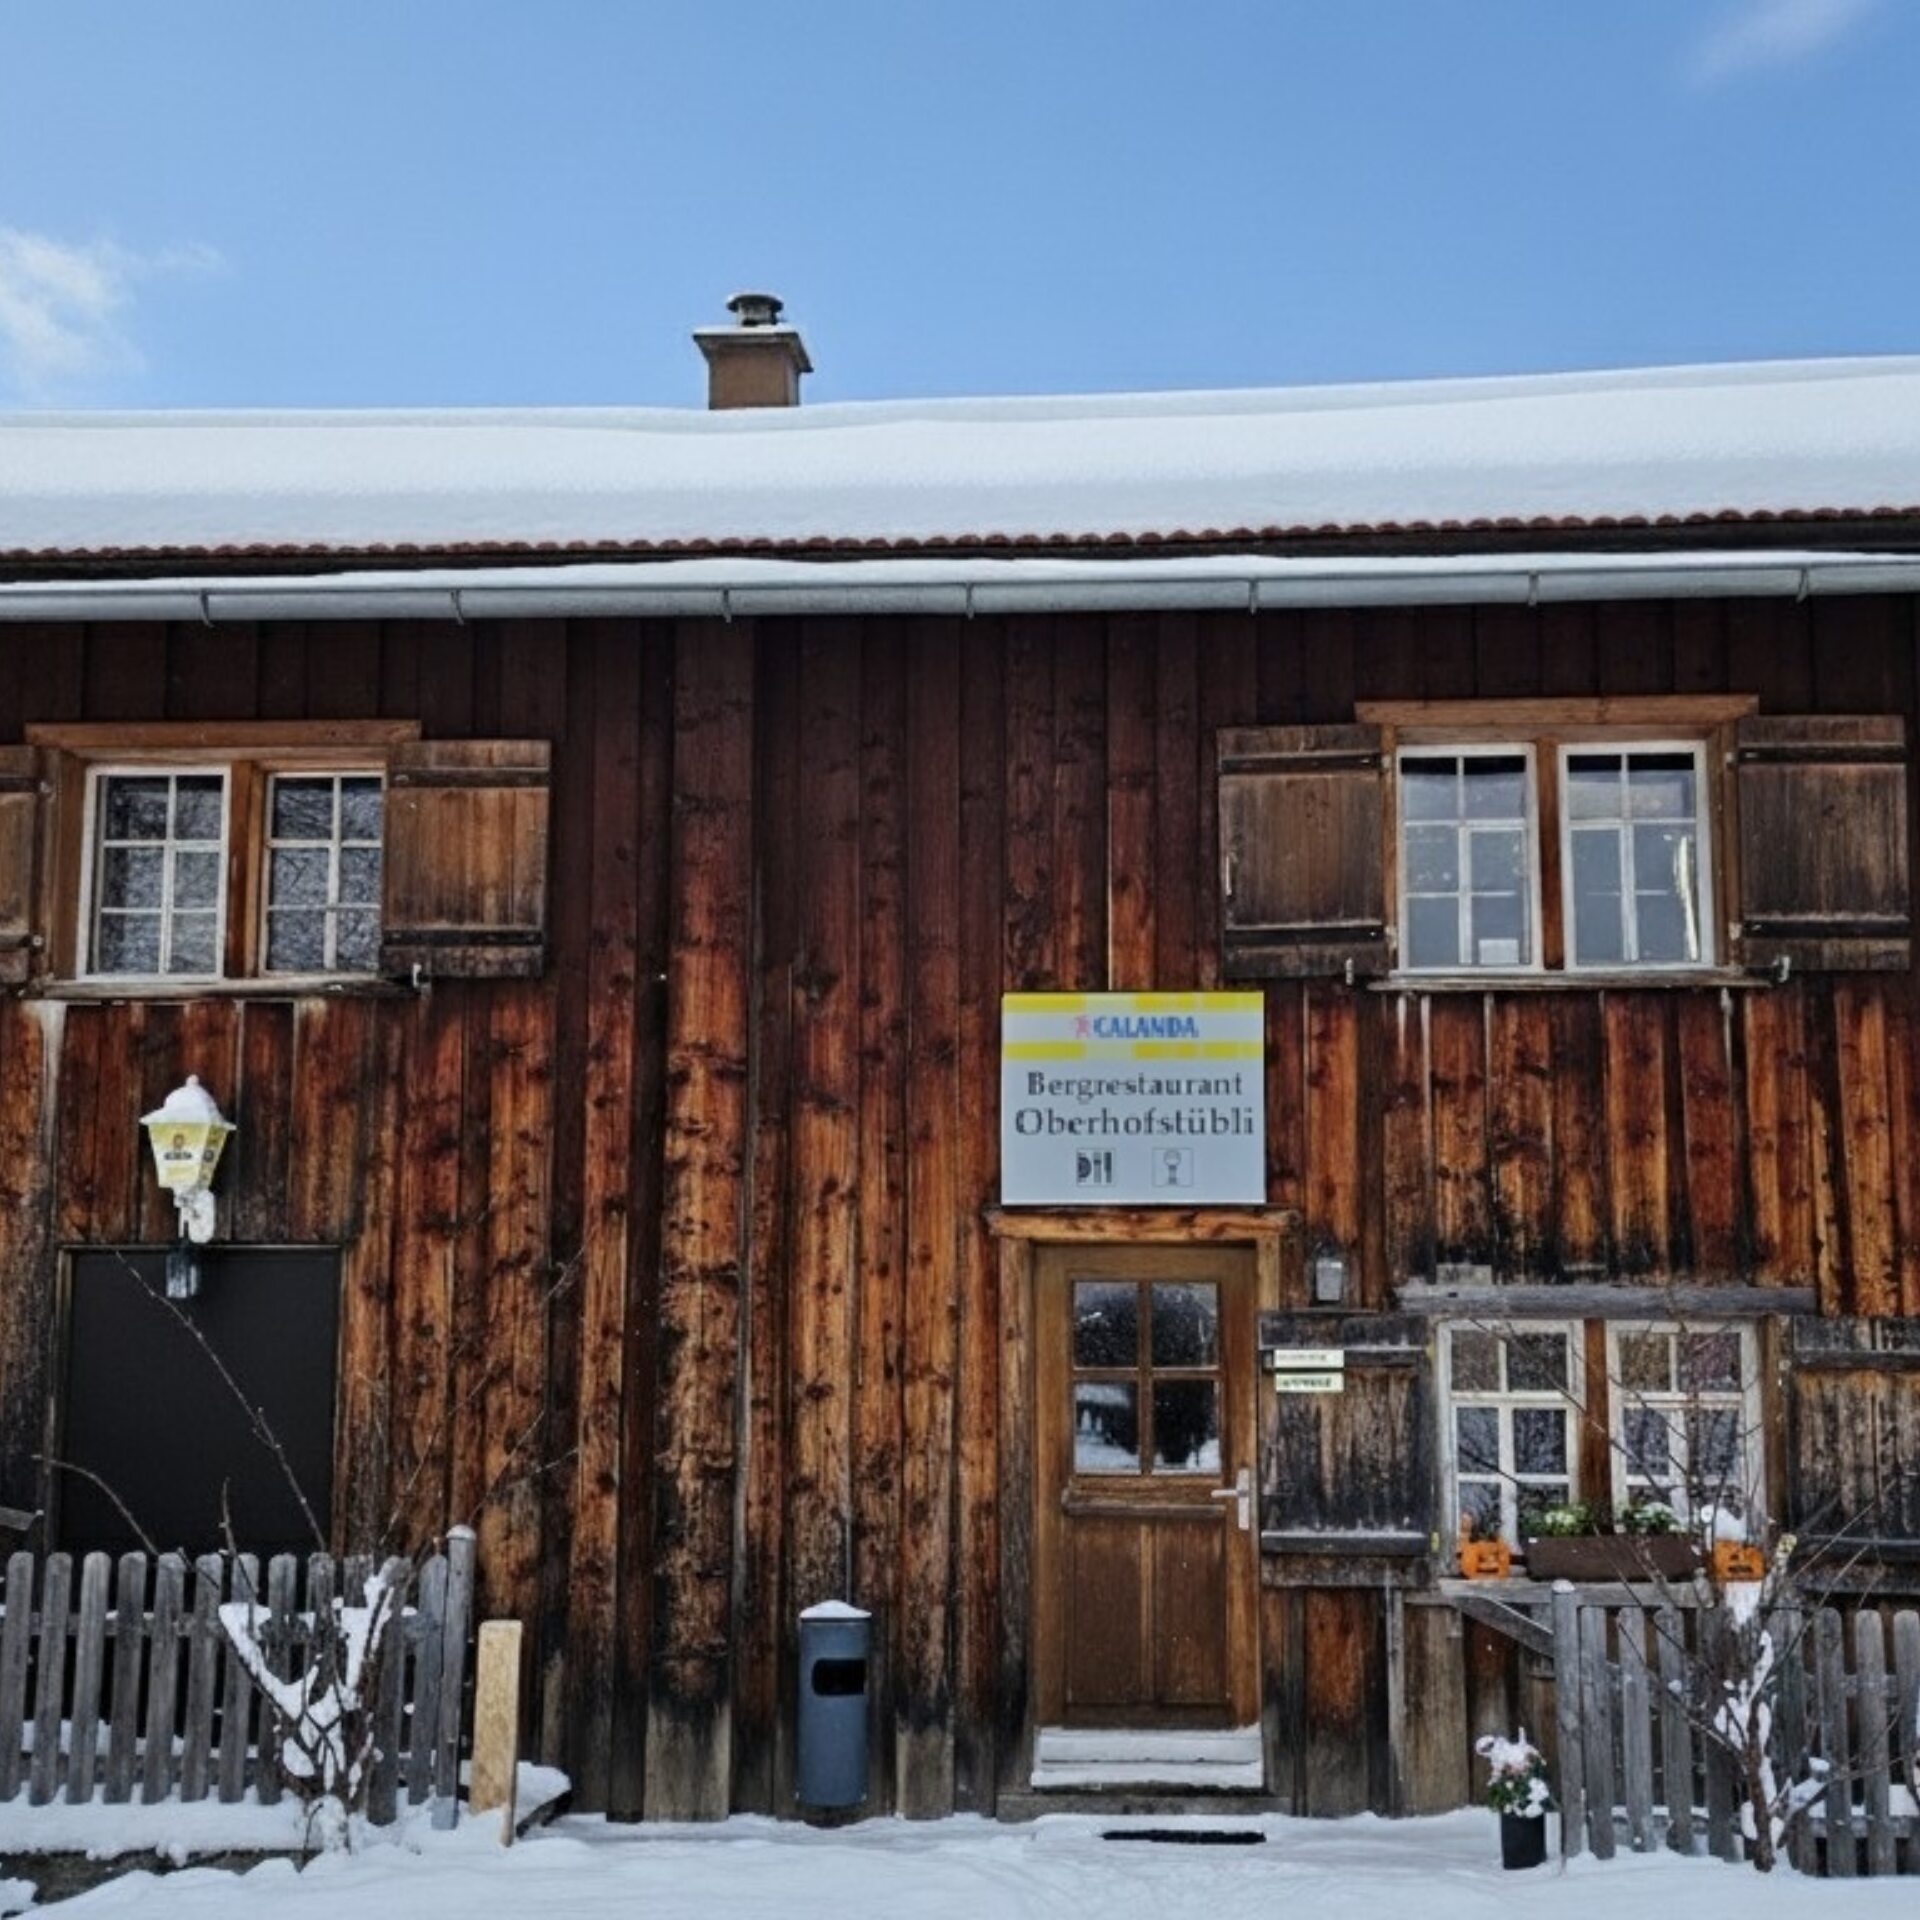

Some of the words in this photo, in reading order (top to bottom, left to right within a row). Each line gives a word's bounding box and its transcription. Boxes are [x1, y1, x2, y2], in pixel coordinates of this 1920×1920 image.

[1093, 1016, 1199, 1038] CALANDA
[1027, 1072, 1242, 1104] Bergrestaurant
[1015, 1107, 1254, 1136] Oberhofstübli
